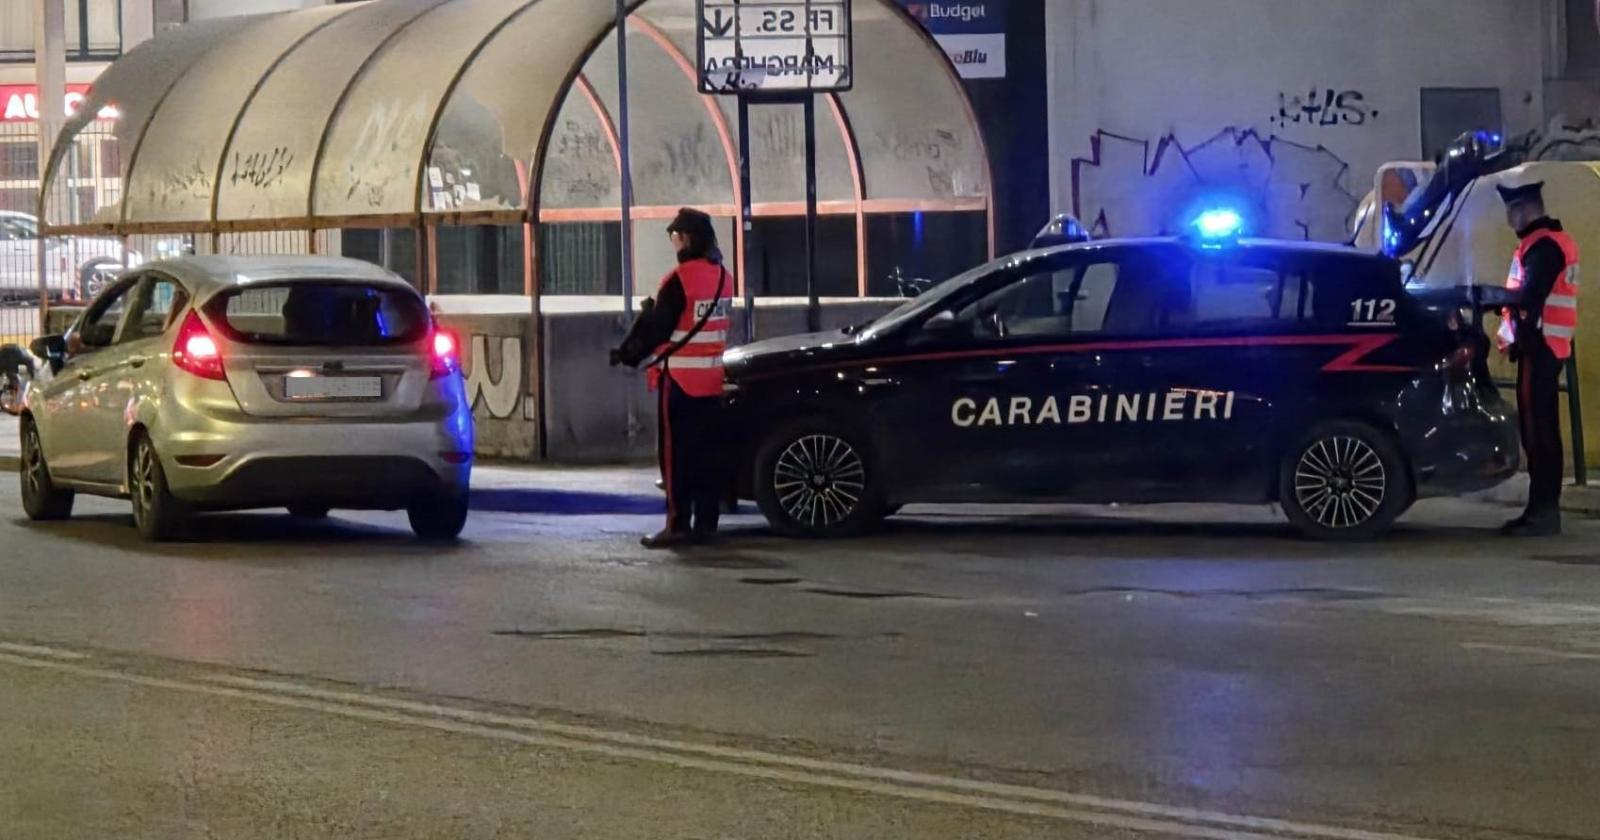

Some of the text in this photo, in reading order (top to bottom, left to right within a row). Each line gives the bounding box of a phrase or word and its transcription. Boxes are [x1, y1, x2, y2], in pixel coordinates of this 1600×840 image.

[930, 3, 985, 21] Budget
[1351, 298, 1396, 321] 112
[951, 391, 1235, 427] CARABINIERI
